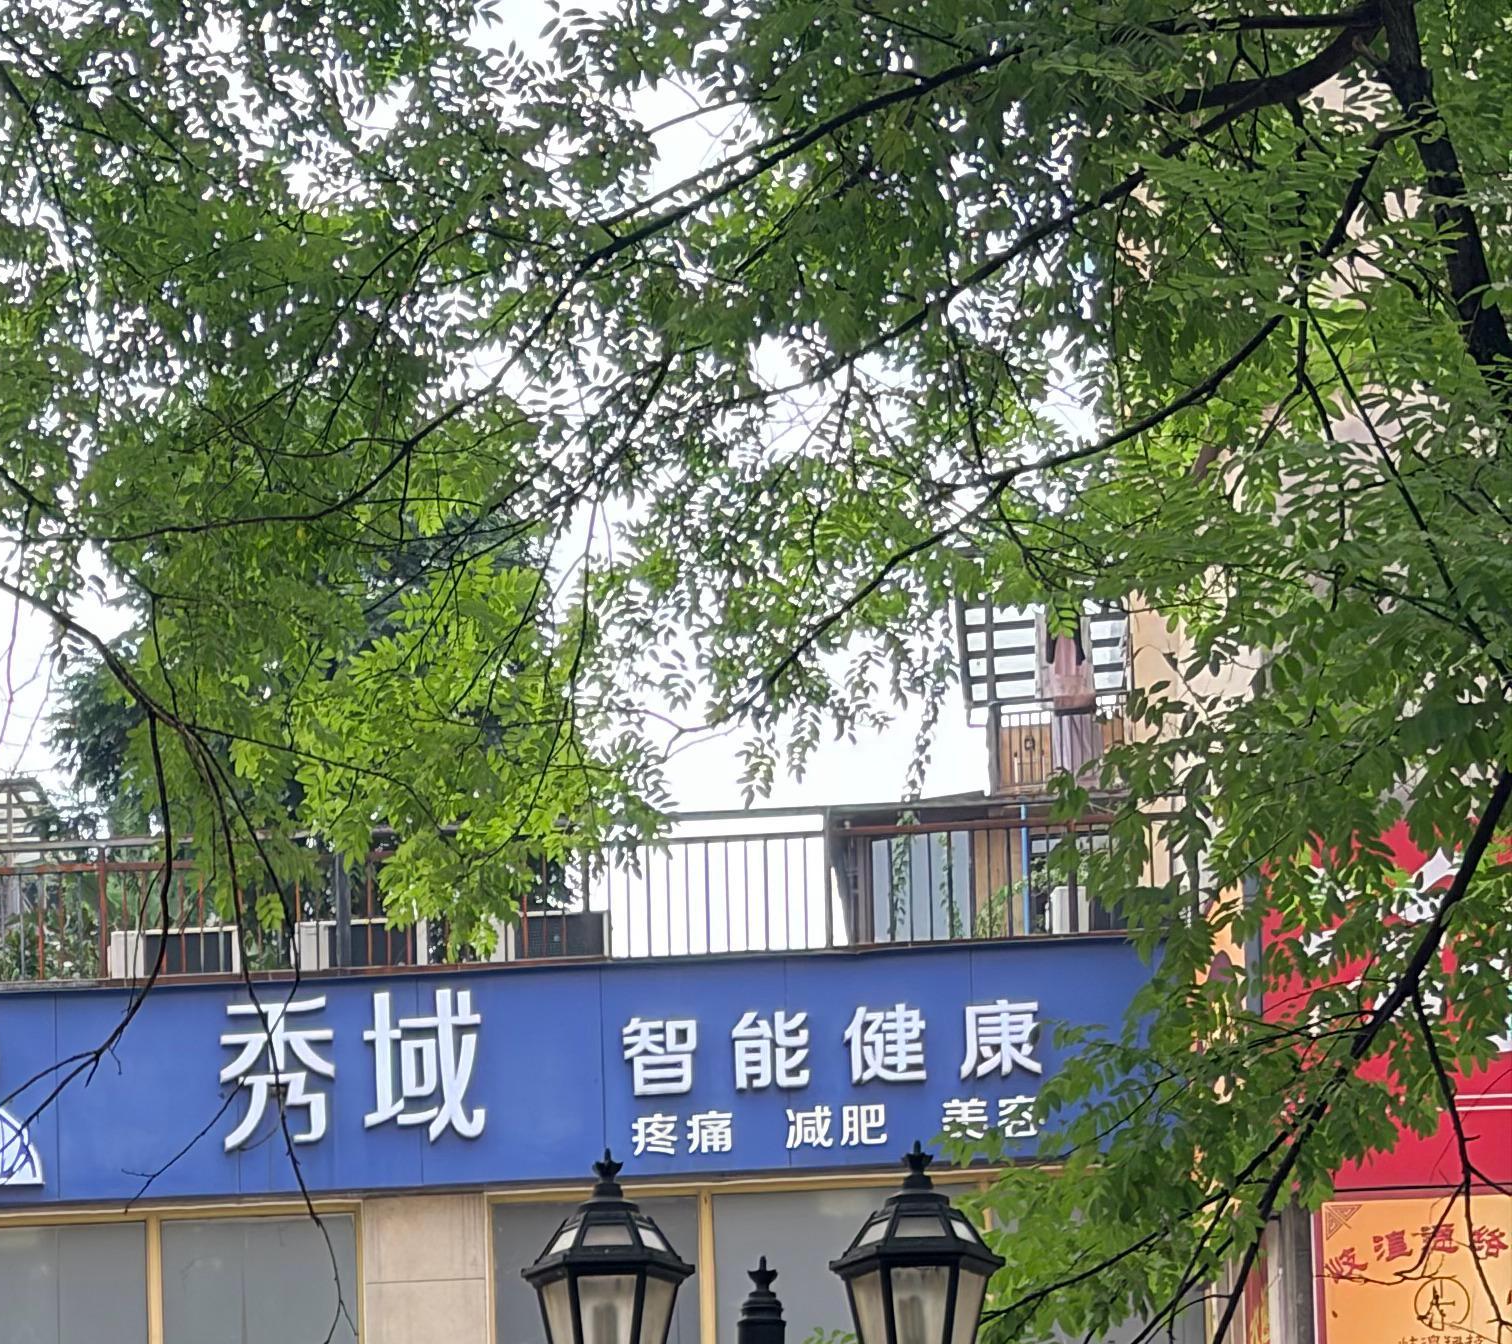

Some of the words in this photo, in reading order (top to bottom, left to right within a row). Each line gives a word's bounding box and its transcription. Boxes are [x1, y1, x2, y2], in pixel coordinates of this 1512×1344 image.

[220, 990, 486, 1151] 秀域
[622, 999, 1044, 1097] 智能健康
[631, 1109, 734, 1156] 疼痛
[785, 1104, 888, 1149] 减肥
